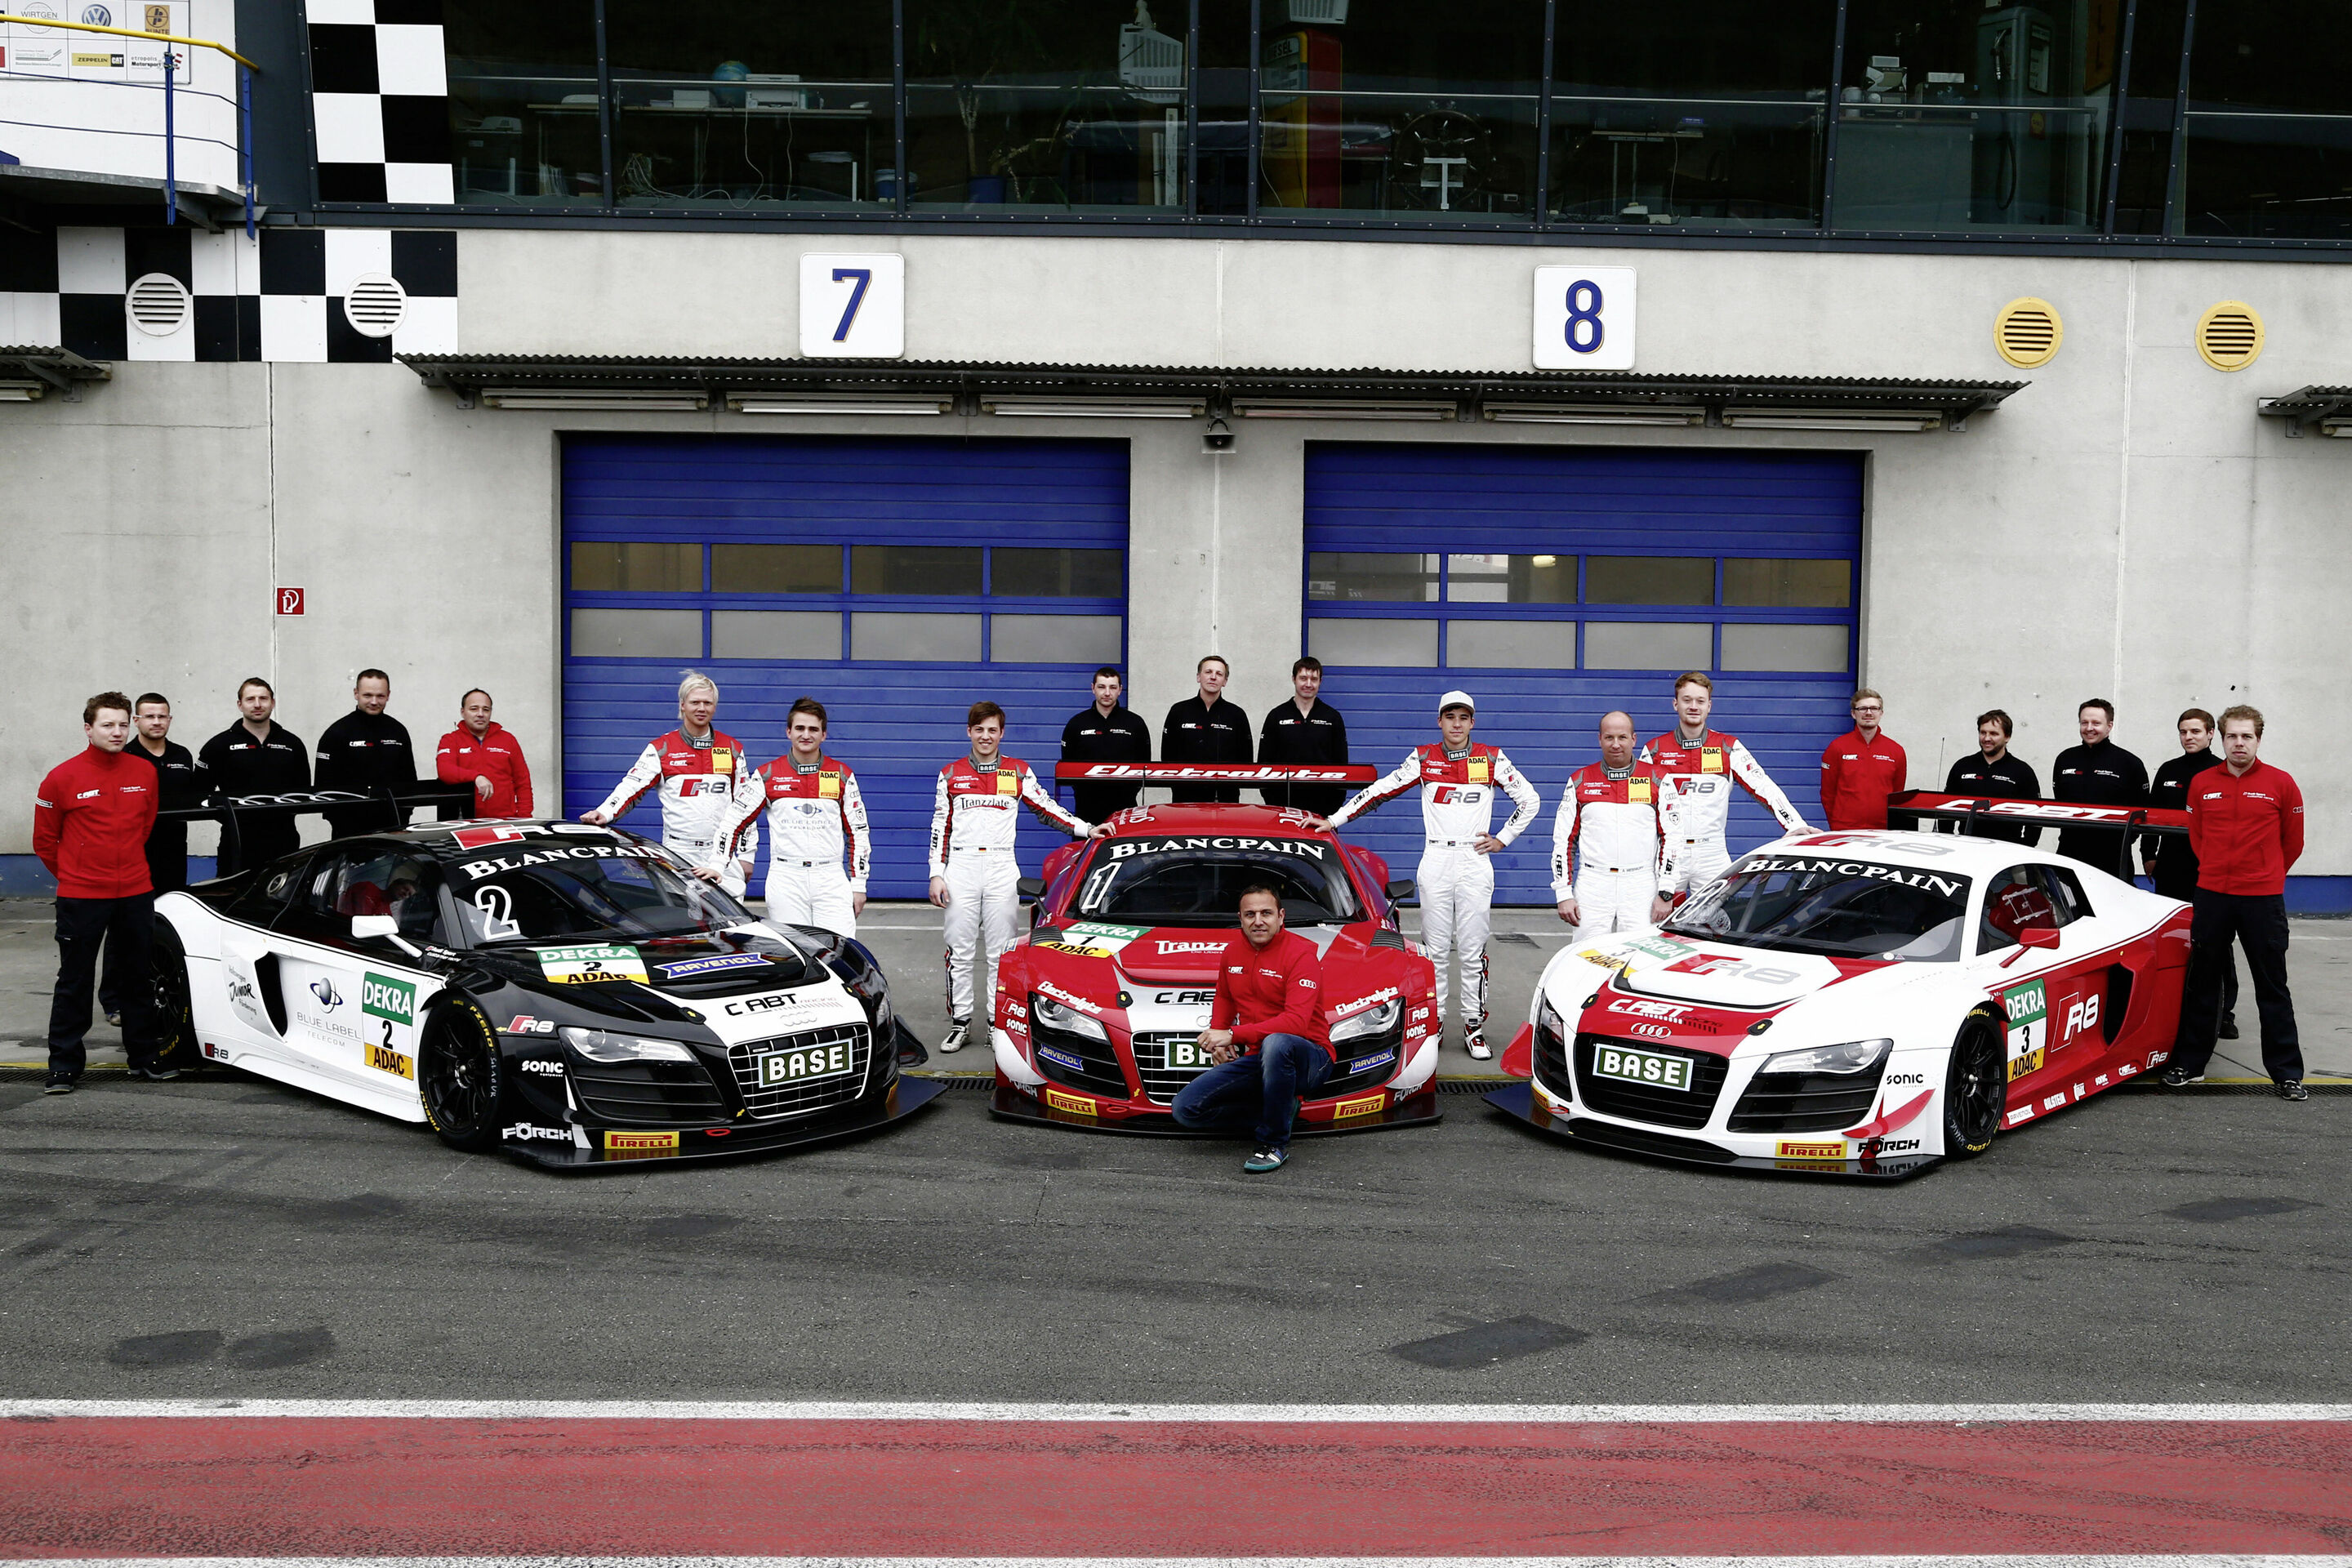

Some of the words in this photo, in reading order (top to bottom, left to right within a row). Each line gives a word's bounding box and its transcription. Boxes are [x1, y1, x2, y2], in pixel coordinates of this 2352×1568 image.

[21, 11, 58, 19] WIRTGEN
[112, 57, 123, 66] CAT
[831, 268, 873, 343] 7
[1564, 278, 1605, 355] 8
[1450, 751, 1467, 759] BASE
[1084, 764, 1348, 779] Electrolyte
[692, 782, 725, 794] R8
[1679, 782, 1715, 794] R8
[960, 797, 1009, 809] Tranzzlate
[1445, 791, 1481, 804] R8
[492, 824, 617, 840] R8
[1109, 838, 1325, 860] BLANCPAIN
[1819, 836, 1957, 857] R8
[459, 846, 673, 880] BLANCPAIN
[1080, 862, 1123, 911] 1
[1739, 859, 1963, 898] BLANCPAIN
[474, 885, 521, 941] 2
[1067, 923, 1140, 939] DEKRA
[1047, 942, 1098, 956] ADAC
[1080, 936, 1097, 945] 1
[540, 947, 639, 961] DEKRA
[1612, 948, 1637, 957] 3
[583, 962, 603, 972] 2
[672, 956, 759, 973] RAVENOL
[1588, 955, 1625, 969] ADAC
[1690, 959, 1802, 985] R8
[363, 980, 412, 1017] DEKRA
[1037, 980, 1103, 1014] Electrolyte
[1335, 986, 1399, 1016] Electrolyte
[2006, 987, 2046, 1021] DEKRA
[1007, 1003, 1027, 1018] R8
[1412, 1007, 1429, 1022] R8
[1967, 1009, 1990, 1019] PIRELLI
[2063, 994, 2100, 1040] R8
[296, 1012, 323, 1027] BLUE
[326, 1022, 361, 1039] LABEL
[382, 1020, 394, 1049] 2
[2021, 1026, 2030, 1054] 3
[373, 1048, 404, 1075] ADAC
[769, 1046, 844, 1082] BASE
[1043, 1046, 1080, 1065] RAVENOL
[1354, 1051, 1391, 1068] RAVENOL
[2150, 1052, 2168, 1065] R8
[1603, 1050, 1682, 1085] BASE
[2011, 1052, 2038, 1080] ADAC
[1050, 1092, 1092, 1113] PIRELLI
[1339, 1098, 1382, 1116] PIRELLI
[2043, 1092, 2067, 1111] BILSTEIN
[2010, 1108, 2031, 1121] RAVENOL
[611, 1134, 672, 1147] PIRELLI
[1781, 1143, 1842, 1156] PIRELLI
